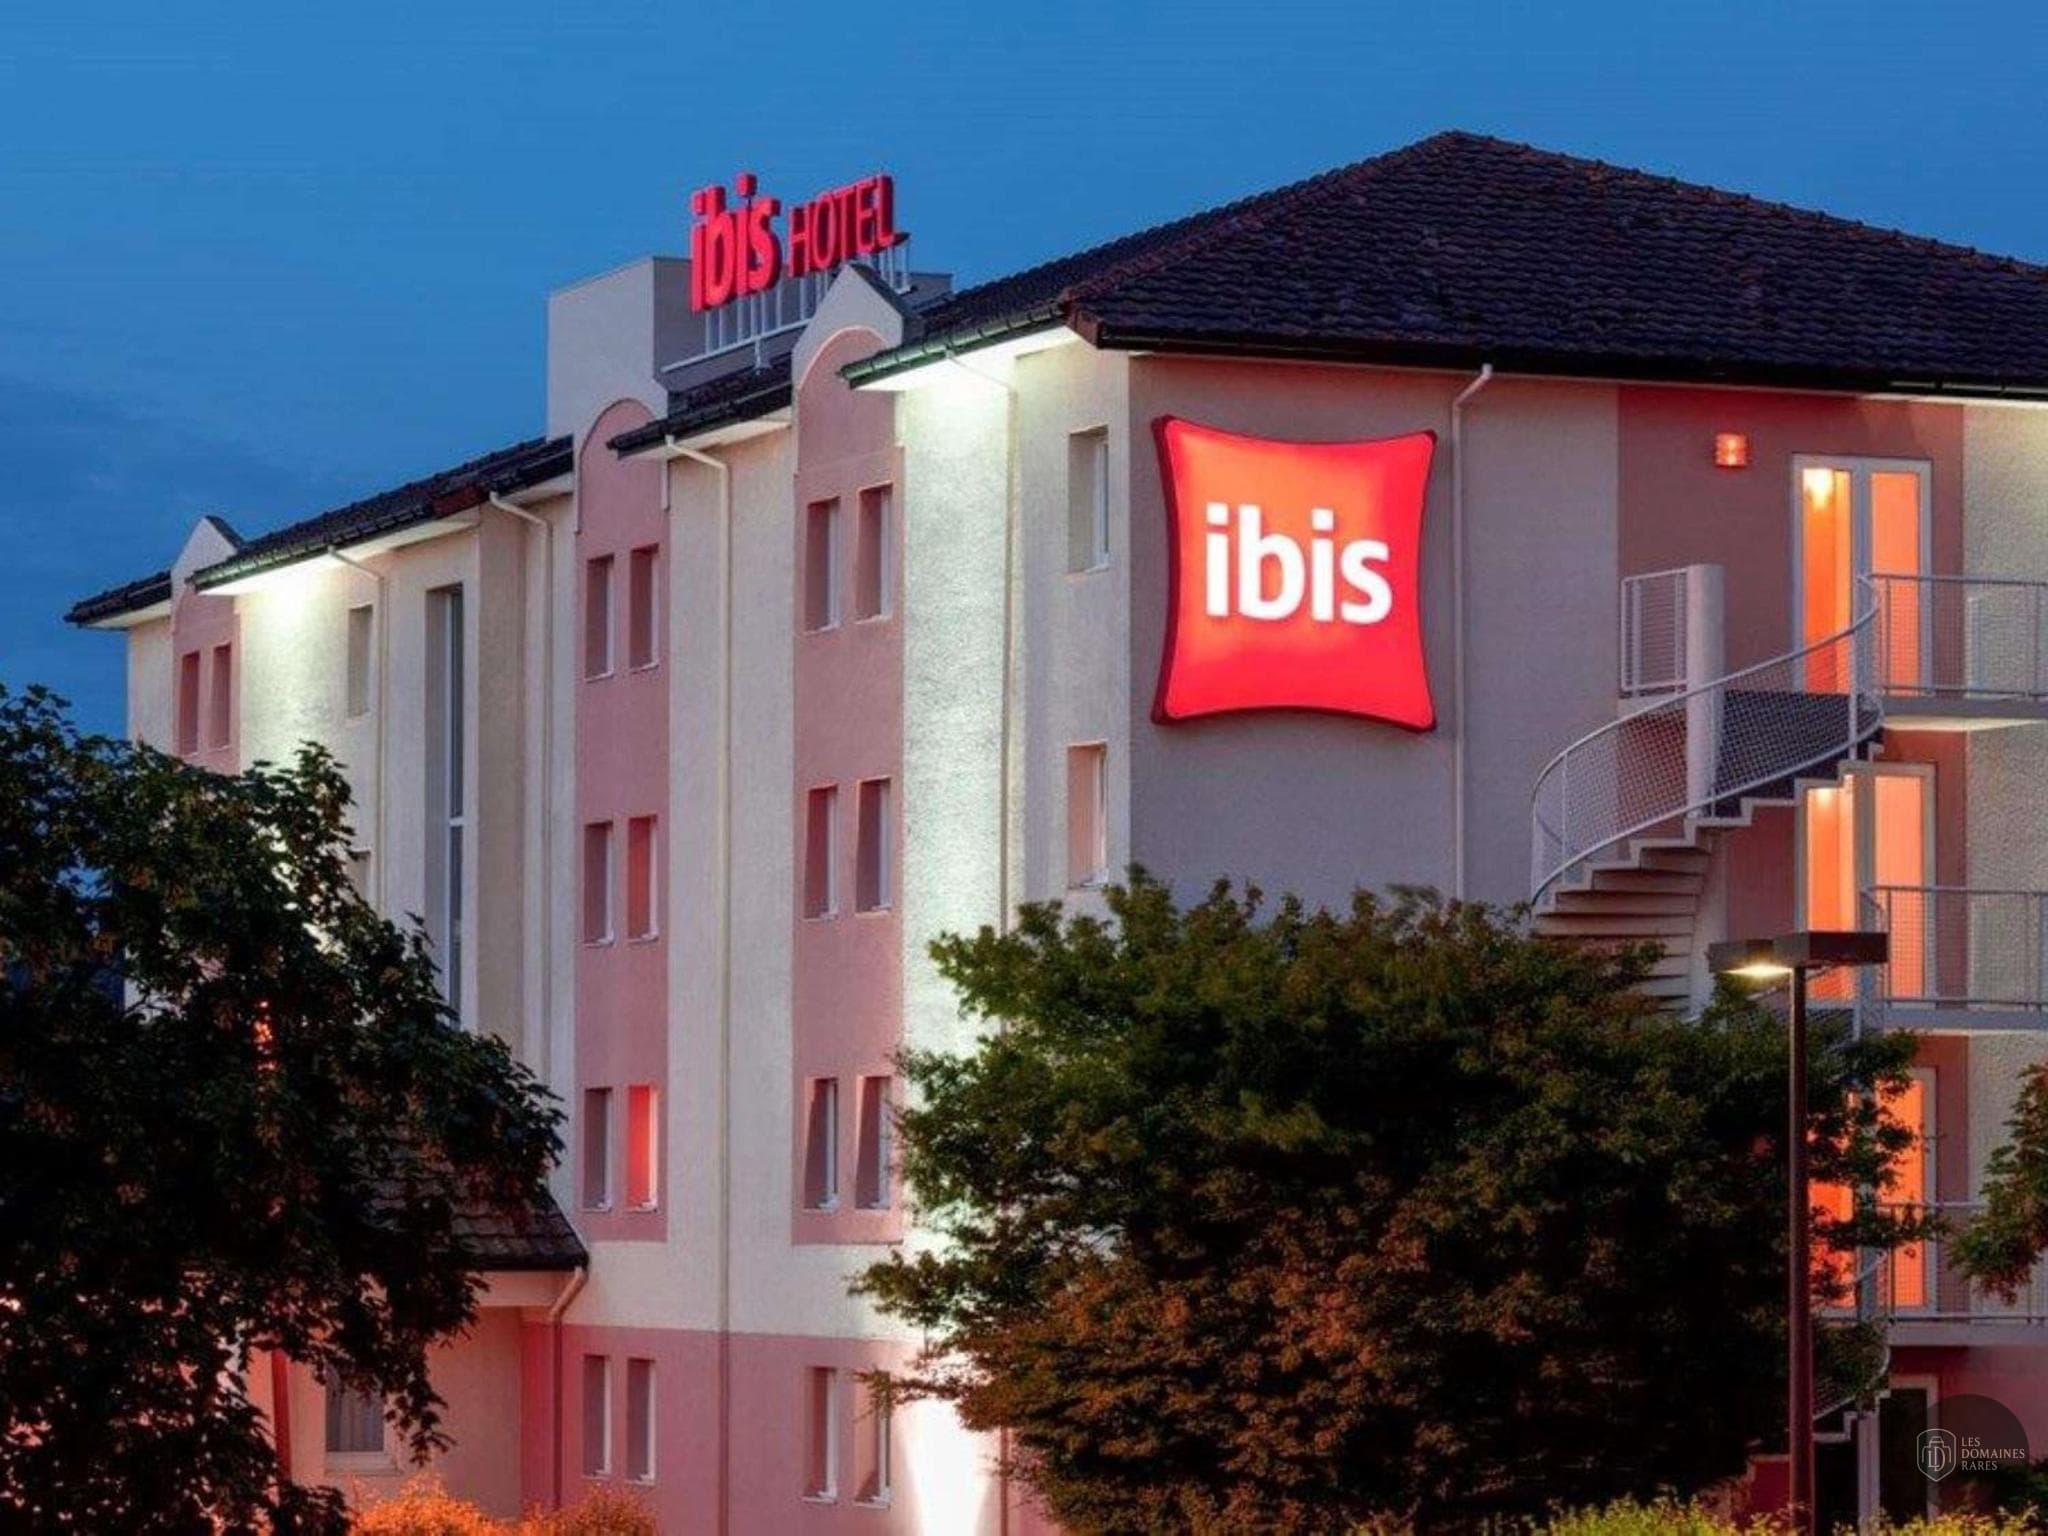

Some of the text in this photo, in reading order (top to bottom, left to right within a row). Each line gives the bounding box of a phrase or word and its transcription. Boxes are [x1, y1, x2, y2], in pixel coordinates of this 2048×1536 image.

[691, 171, 908, 313] ibis HOTEL
[1205, 502, 1394, 625] ibis
